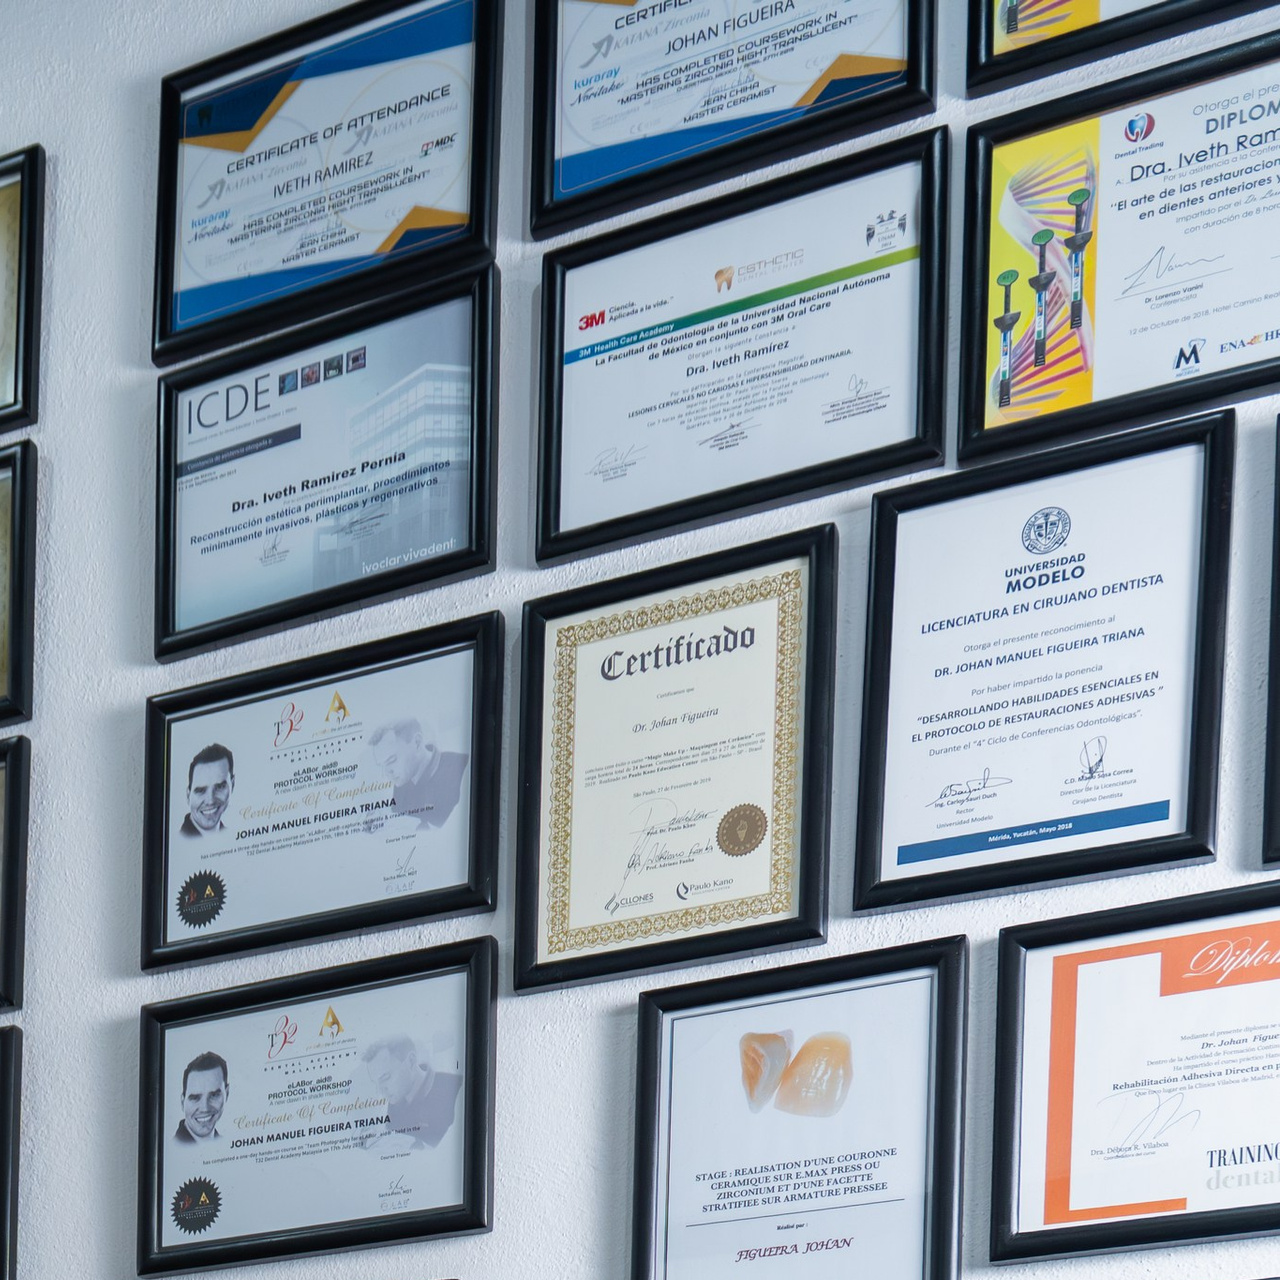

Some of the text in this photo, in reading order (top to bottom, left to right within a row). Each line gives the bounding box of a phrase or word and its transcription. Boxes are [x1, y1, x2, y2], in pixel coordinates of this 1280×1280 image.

[665, 0, 796, 55] JOHAN FIGUEIRA
[636, 11, 837, 90] HAS COMPLETED COURSEWORK IN
[226, 84, 450, 174] CERTIFICATE OF ATTENDANCE
[434, 132, 458, 148] MDC
[1114, 140, 1164, 160] Dental Trading
[273, 152, 374, 198] IVETH RAMIREZ
[1130, 140, 1229, 182] Dra. Iveth
[578, 309, 605, 331] 3M
[686, 340, 789, 377] Dra. Iveth Ramírez
[188, 373, 270, 434] ICDE
[190, 516, 262, 545] Reconstrucción
[265, 504, 302, 522] estética
[373, 459, 451, 490] procedimientos
[232, 495, 258, 513] Dra.
[263, 484, 296, 504] Iveth
[361, 451, 405, 473] Pernía
[1004, 552, 1086, 578] UNIVERSIDAD
[1005, 564, 1086, 594] MODELO
[921, 573, 1164, 635] LICENCIATURA EN CIRUJANO DENTISTA
[600, 624, 756, 681] Certificado
[934, 627, 1145, 678] DR. JOHAN MANUEL FIGUEIRA TRIANA
[632, 705, 719, 734] Dr. Johan Figueira
[236, 797, 397, 841] JOHAN MANUEL FIGUEIRA TRIANA
[1201, 1037, 1248, 1050] Dr. Johan
[1112, 1067, 1259, 1091] Rehabilitación Adhesiva Directa
[802, 1237, 854, 1256] JOHAN
